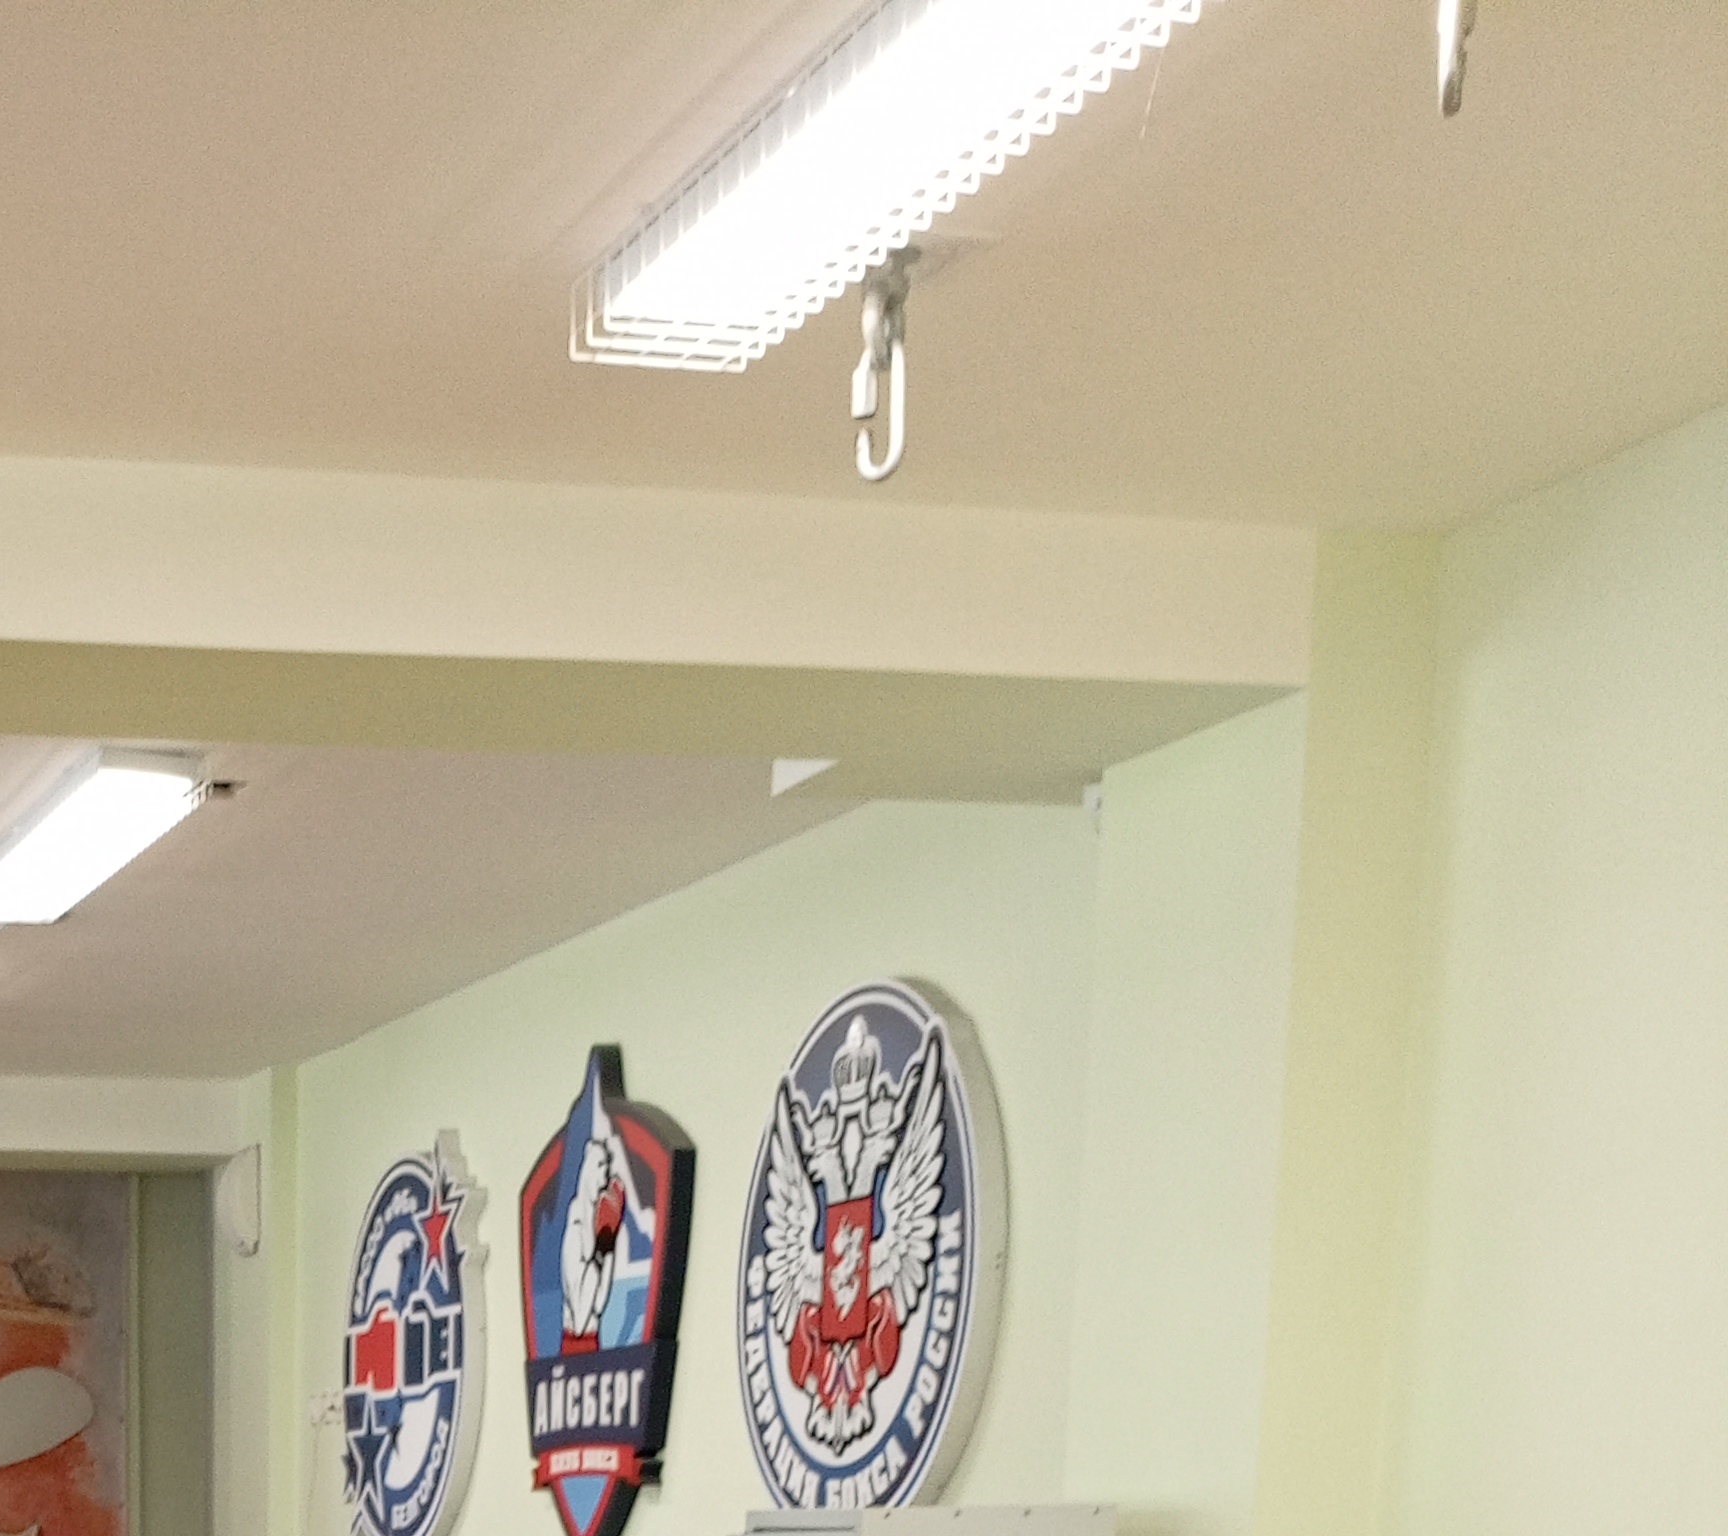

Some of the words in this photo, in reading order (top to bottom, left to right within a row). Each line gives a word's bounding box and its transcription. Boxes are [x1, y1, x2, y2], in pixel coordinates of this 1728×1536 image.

[534, 1365, 645, 1437] АЙСБЕРГ
[745, 1254, 822, 1508] ФЕДЕРАЦИЯ
[824, 1435, 908, 1508] БОКСА
[902, 1210, 962, 1440] РОССИИ
